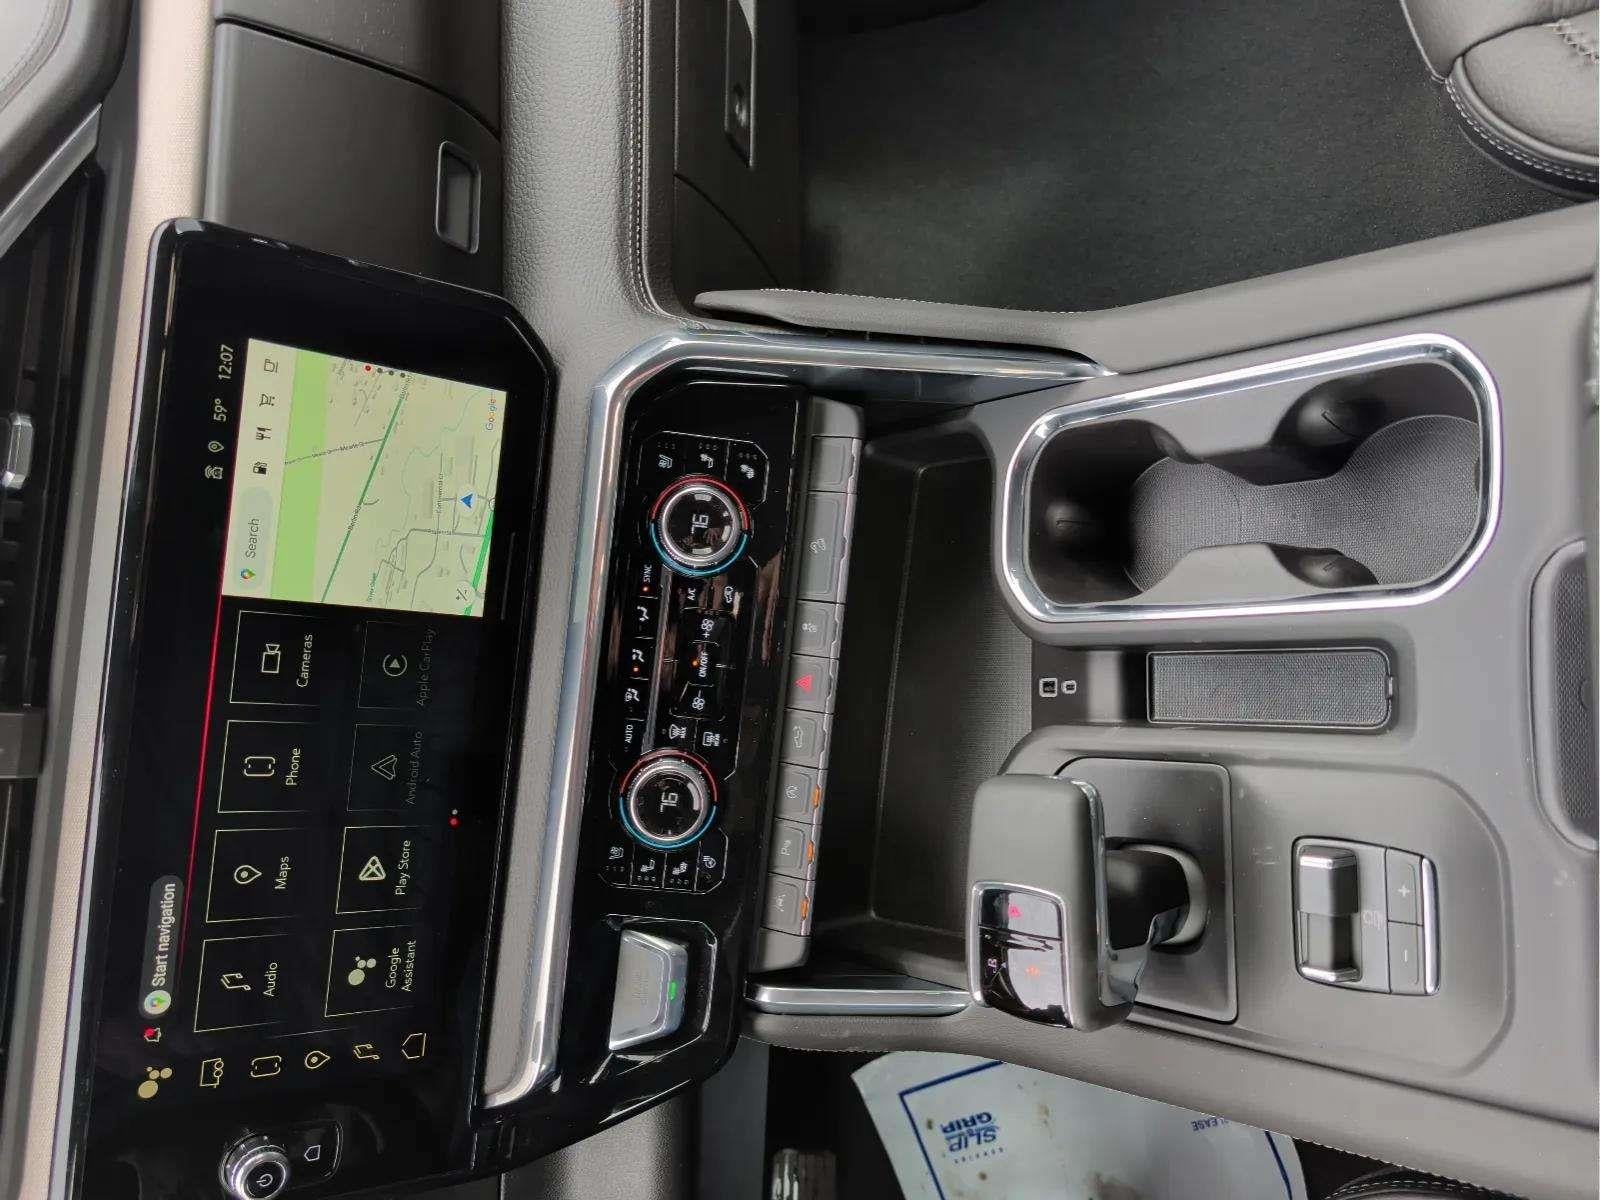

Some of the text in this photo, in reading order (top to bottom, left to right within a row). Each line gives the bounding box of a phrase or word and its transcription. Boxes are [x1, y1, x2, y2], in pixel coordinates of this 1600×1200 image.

[218, 344, 234, 380] 12:07
[484, 398, 498, 431] Google
[244, 518, 260, 558] Search
[691, 514, 709, 534] 76
[644, 564, 652, 582] SYNC
[688, 588, 696, 600] A/C
[296, 634, 313, 688] Cameras
[416, 627, 436, 706] Apple CarPlay
[698, 652, 709, 678] ON/OFF
[625, 724, 634, 744] AUTO
[286, 748, 302, 786] Phone
[406, 732, 423, 804] Android Auto
[660, 792, 679, 812] 76
[274, 856, 291, 890] Maps
[396, 840, 412, 895] Play Store
[152, 884, 178, 986] Start navigation
[264, 962, 278, 997] Audio
[386, 948, 402, 988] Google
[402, 940, 417, 992] Assistant
[941, 1112, 992, 1133] GRIP
[949, 1128, 997, 1152] SLIP
